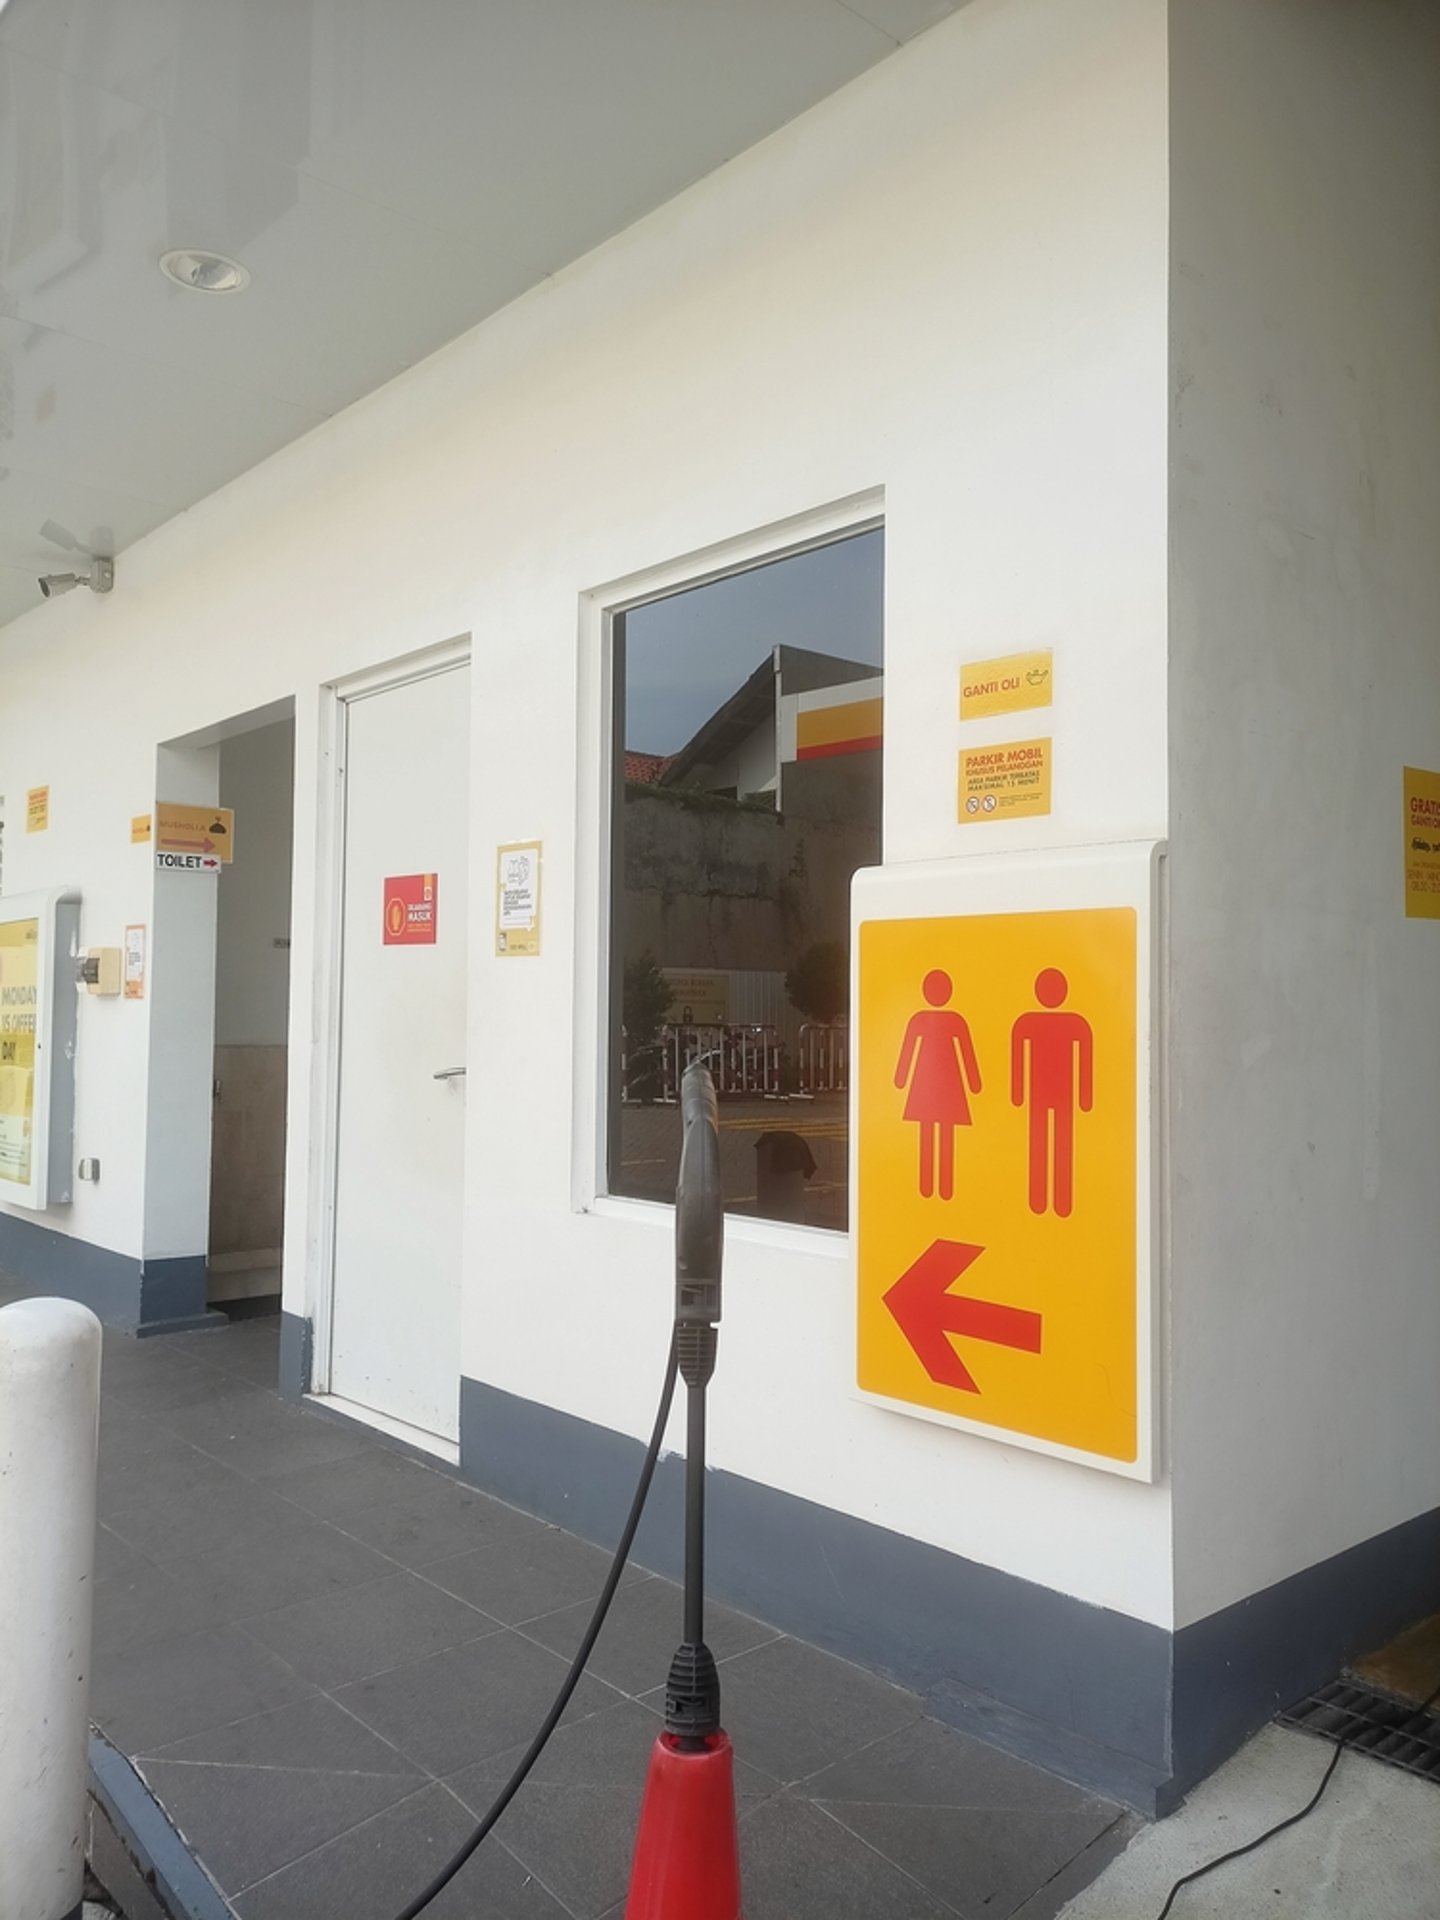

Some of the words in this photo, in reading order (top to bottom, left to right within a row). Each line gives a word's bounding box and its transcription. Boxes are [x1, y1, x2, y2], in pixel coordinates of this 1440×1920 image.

[963, 681, 999, 698] GANTI
[1001, 678, 1020, 691] OLI
[966, 752, 1004, 768] PARKIR
[1007, 747, 1043, 762] MOBIL
[157, 854, 202, 868] TOILET
[408, 911, 432, 922] MASUK
[2, 986, 37, 1006] MONDAY
